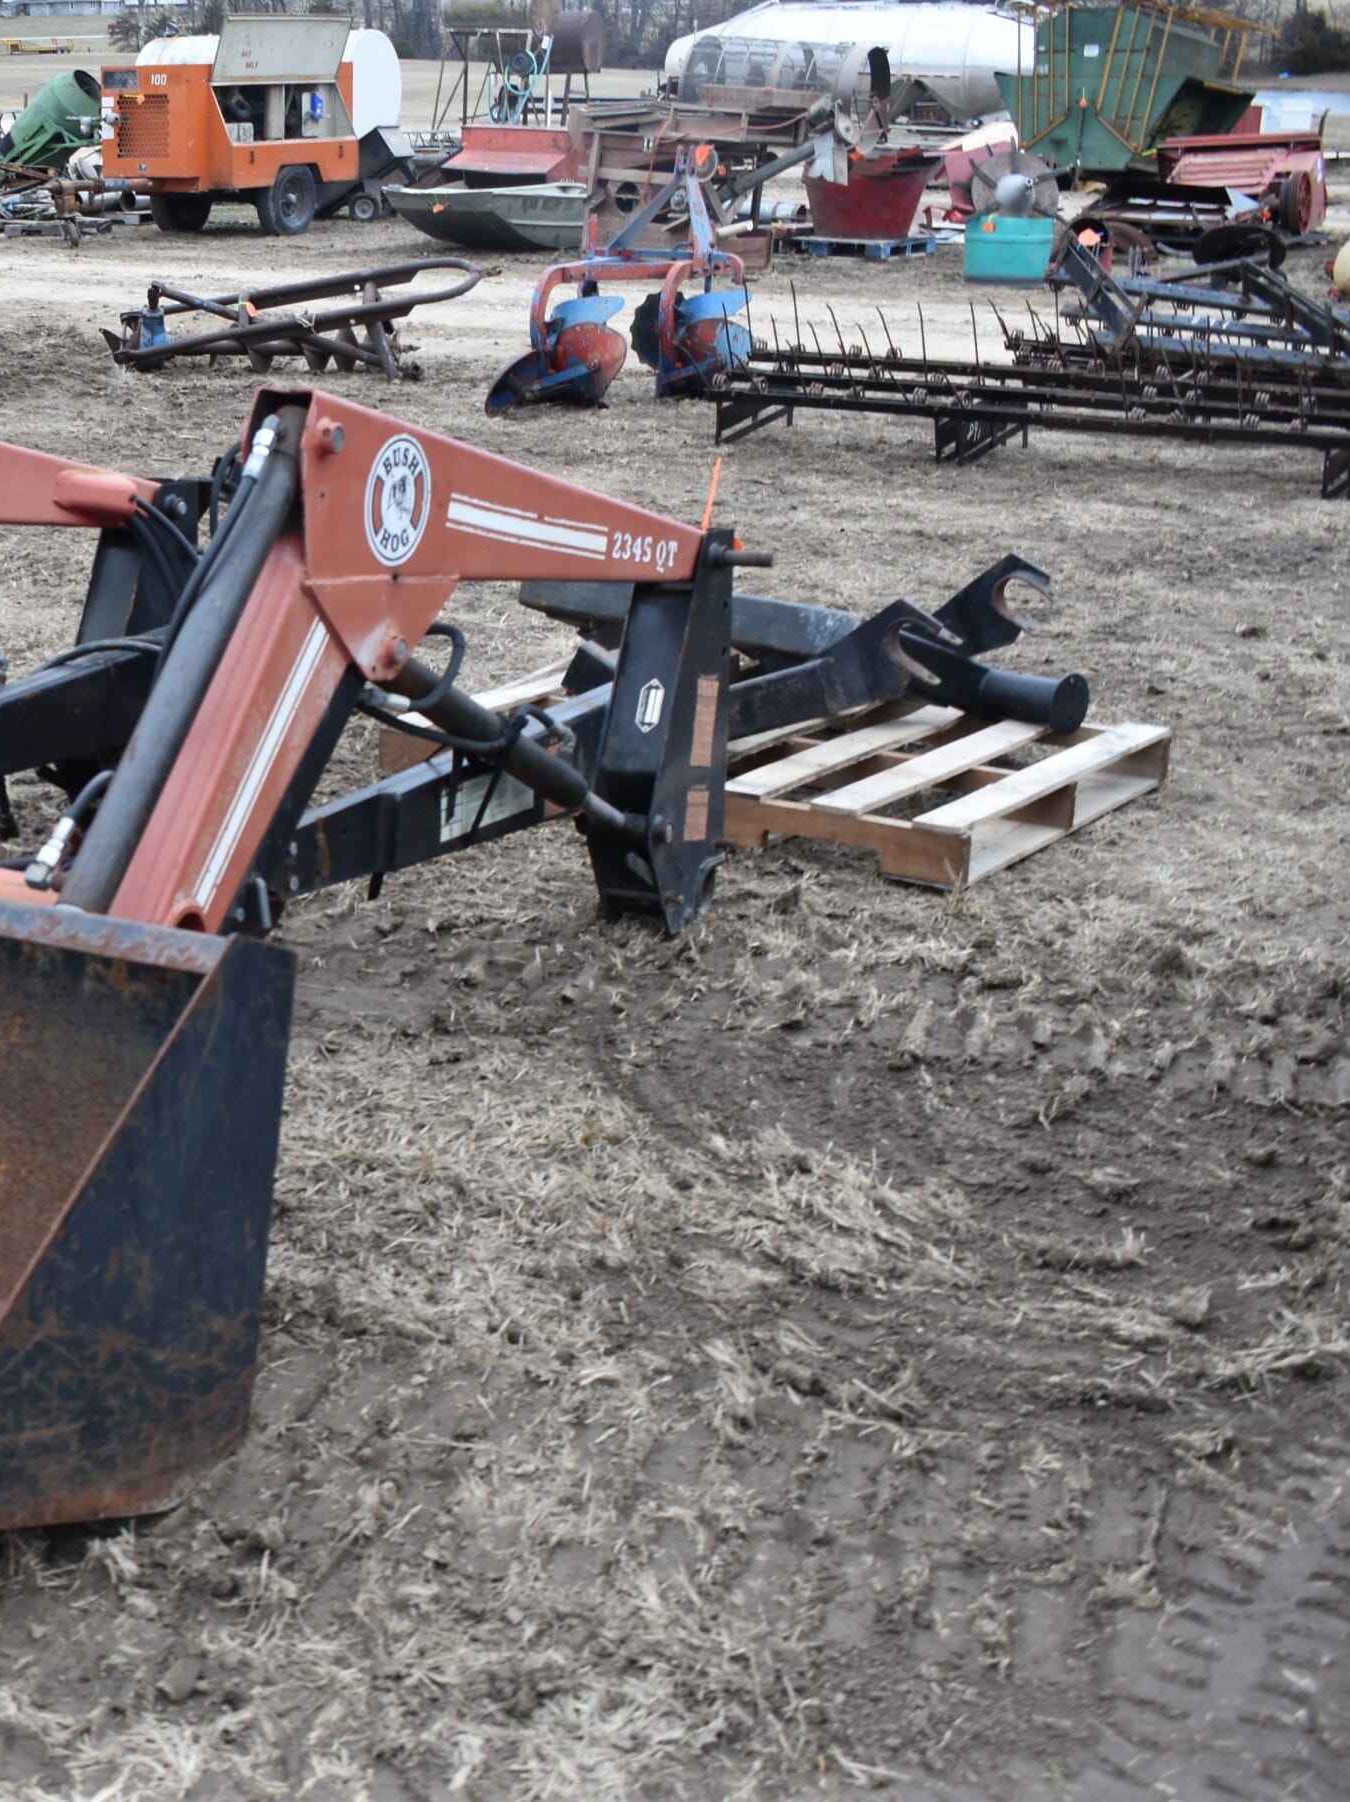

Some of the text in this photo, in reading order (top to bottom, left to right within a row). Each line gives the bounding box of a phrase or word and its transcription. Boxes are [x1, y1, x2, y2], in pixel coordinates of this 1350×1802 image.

[151, 74, 168, 86] 100
[382, 446, 420, 477] BUSH
[380, 527, 410, 553] HOG
[612, 531, 679, 574] 2345 QT
